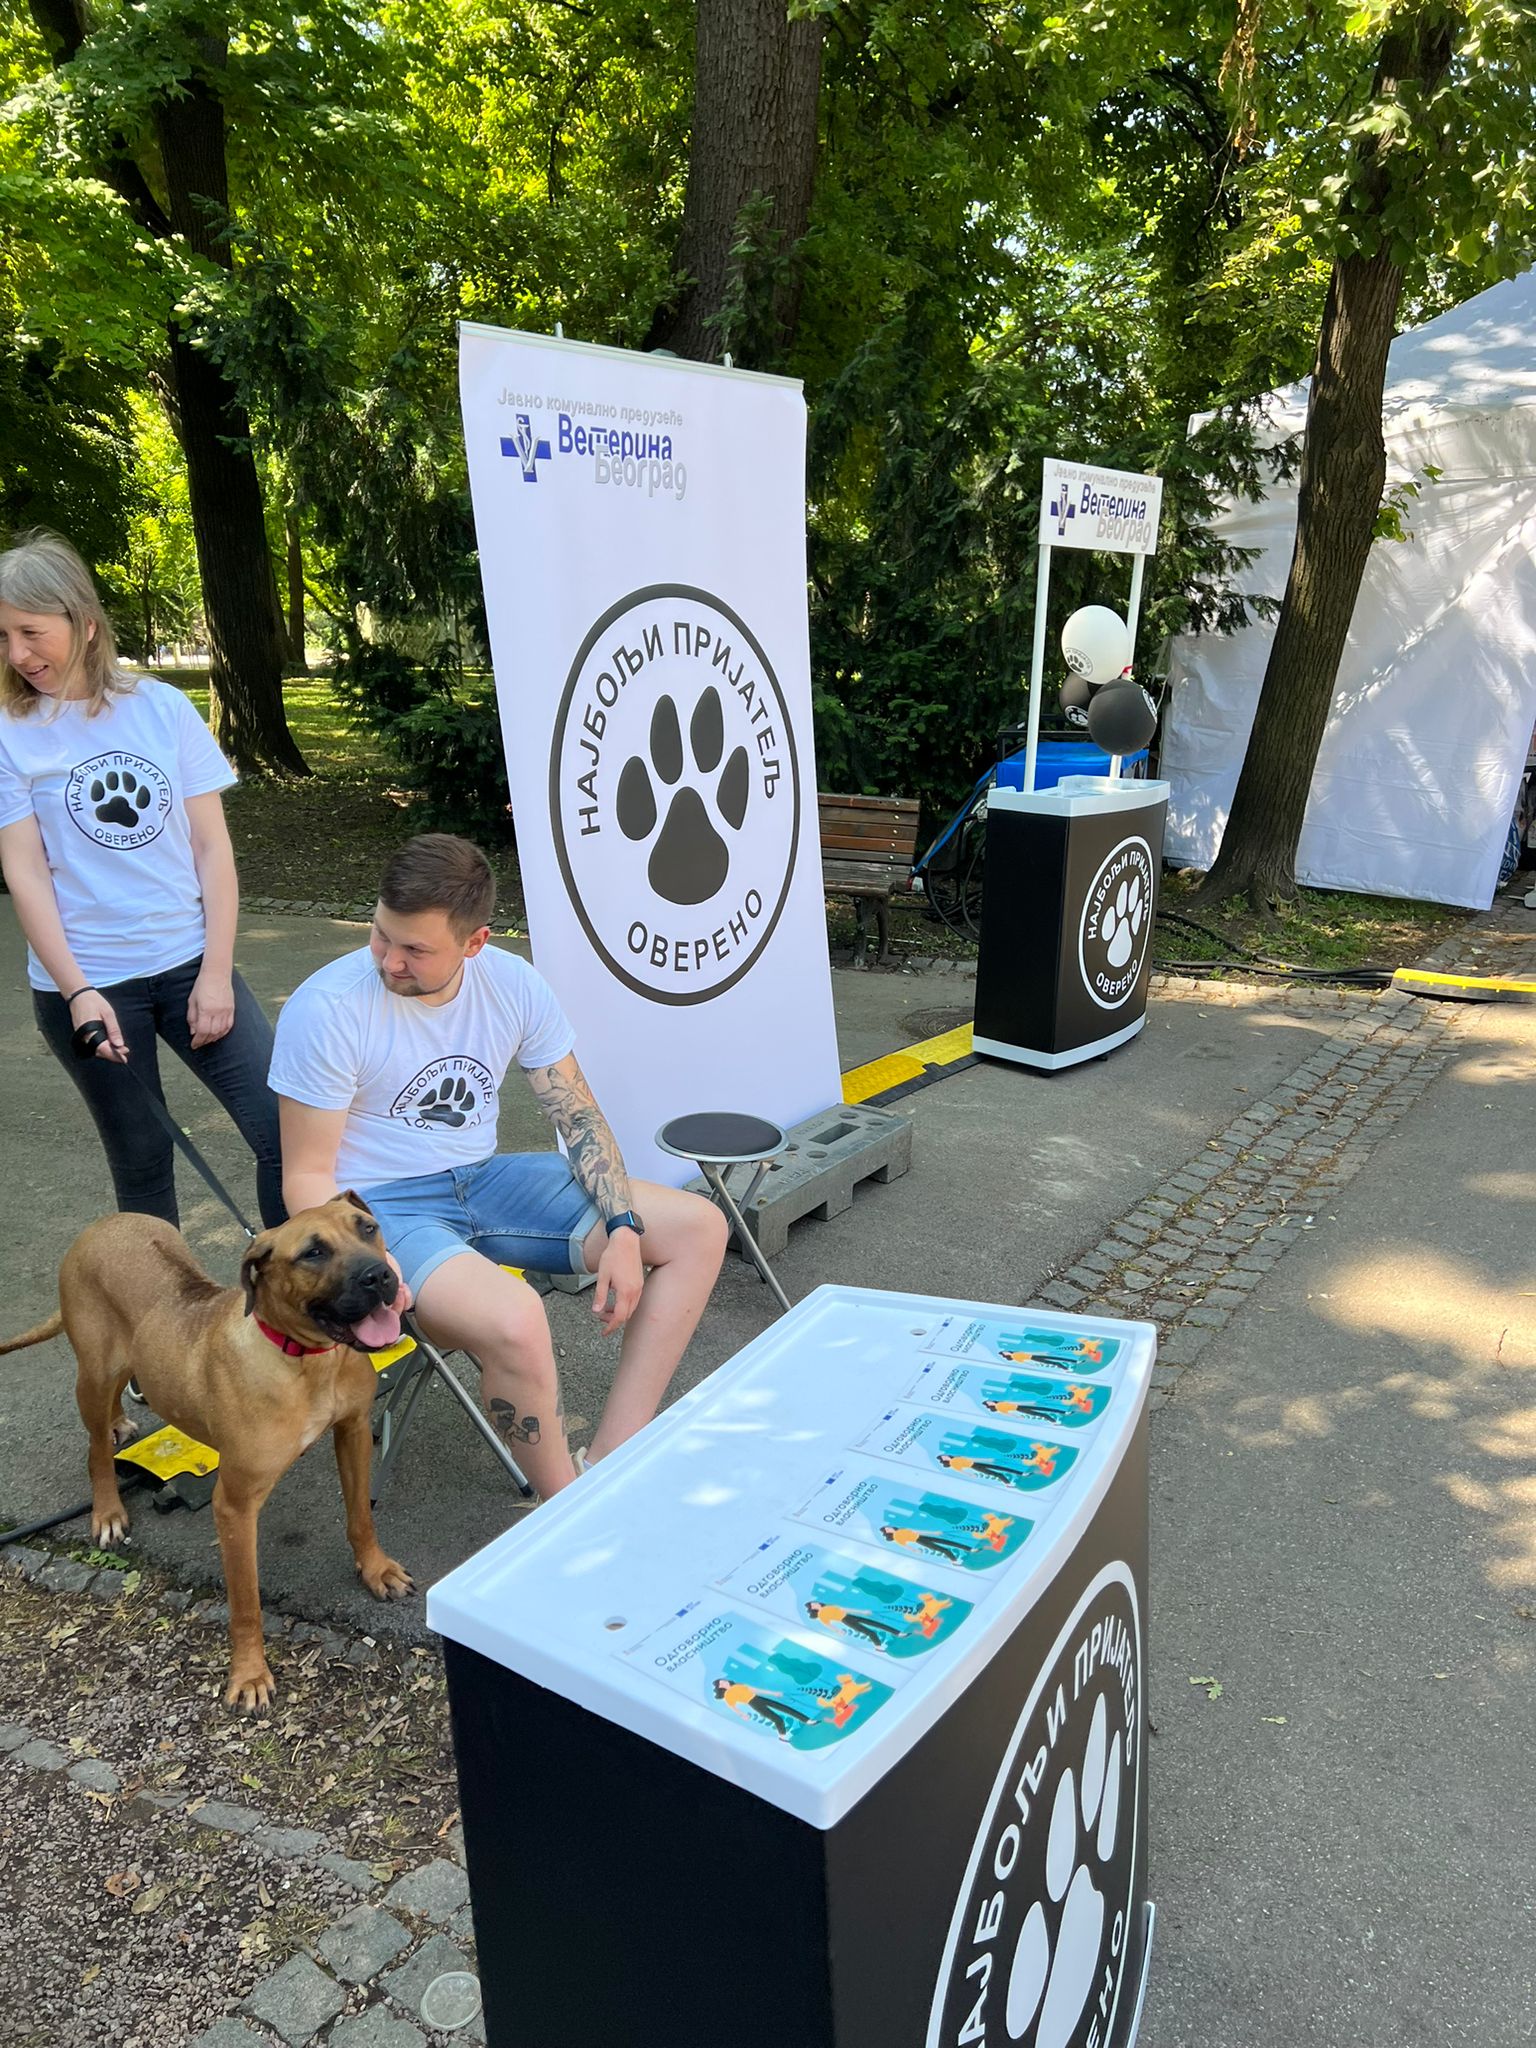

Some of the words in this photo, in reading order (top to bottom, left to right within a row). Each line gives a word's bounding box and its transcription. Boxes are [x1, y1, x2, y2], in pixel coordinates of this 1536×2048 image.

[546, 396, 618, 418] комунално
[559, 413, 673, 462] Ветерина
[594, 445, 688, 500] Београд
[1096, 507, 1152, 551] Београд
[577, 623, 665, 836] НАЈБОЉИ
[673, 621, 781, 800] ПРИЈАТЕЉ
[113, 755, 169, 812] ПРИЈАТЕЉ
[94, 825, 156, 846] ОВЕРЕНО
[1087, 853, 1128, 940] НАЈБОЉИ
[626, 888, 762, 972] ОВЕРЕНО
[1095, 959, 1138, 996] ОВЕРЕНО
[746, 1549, 802, 1594] Одговорно
[654, 1617, 722, 1667] Одговорно
[958, 1682, 1067, 2048] АЈБОЉИ
[1073, 1614, 1135, 1767] ПРИЈАТЕЉ
